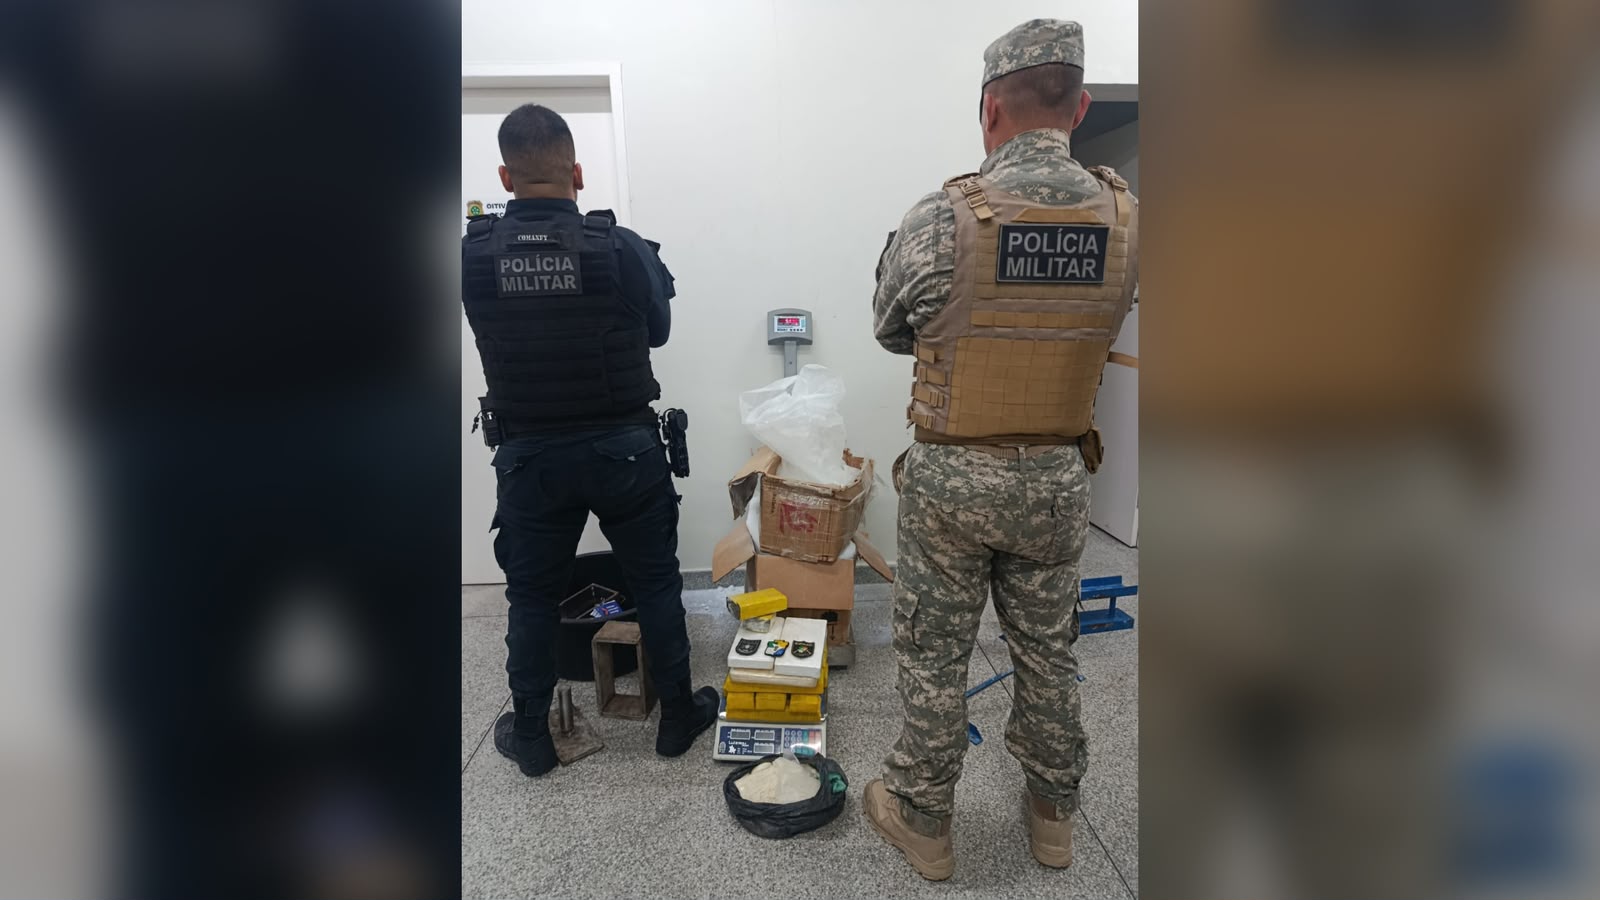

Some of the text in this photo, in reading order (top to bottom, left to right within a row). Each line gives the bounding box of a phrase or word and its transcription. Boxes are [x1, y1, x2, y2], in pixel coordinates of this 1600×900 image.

[1007, 228, 1099, 254] POLÍCIA
[500, 254, 574, 273] POLÍCIA
[1006, 256, 1097, 279] MILITAR
[501, 275, 577, 292] MILITAR
